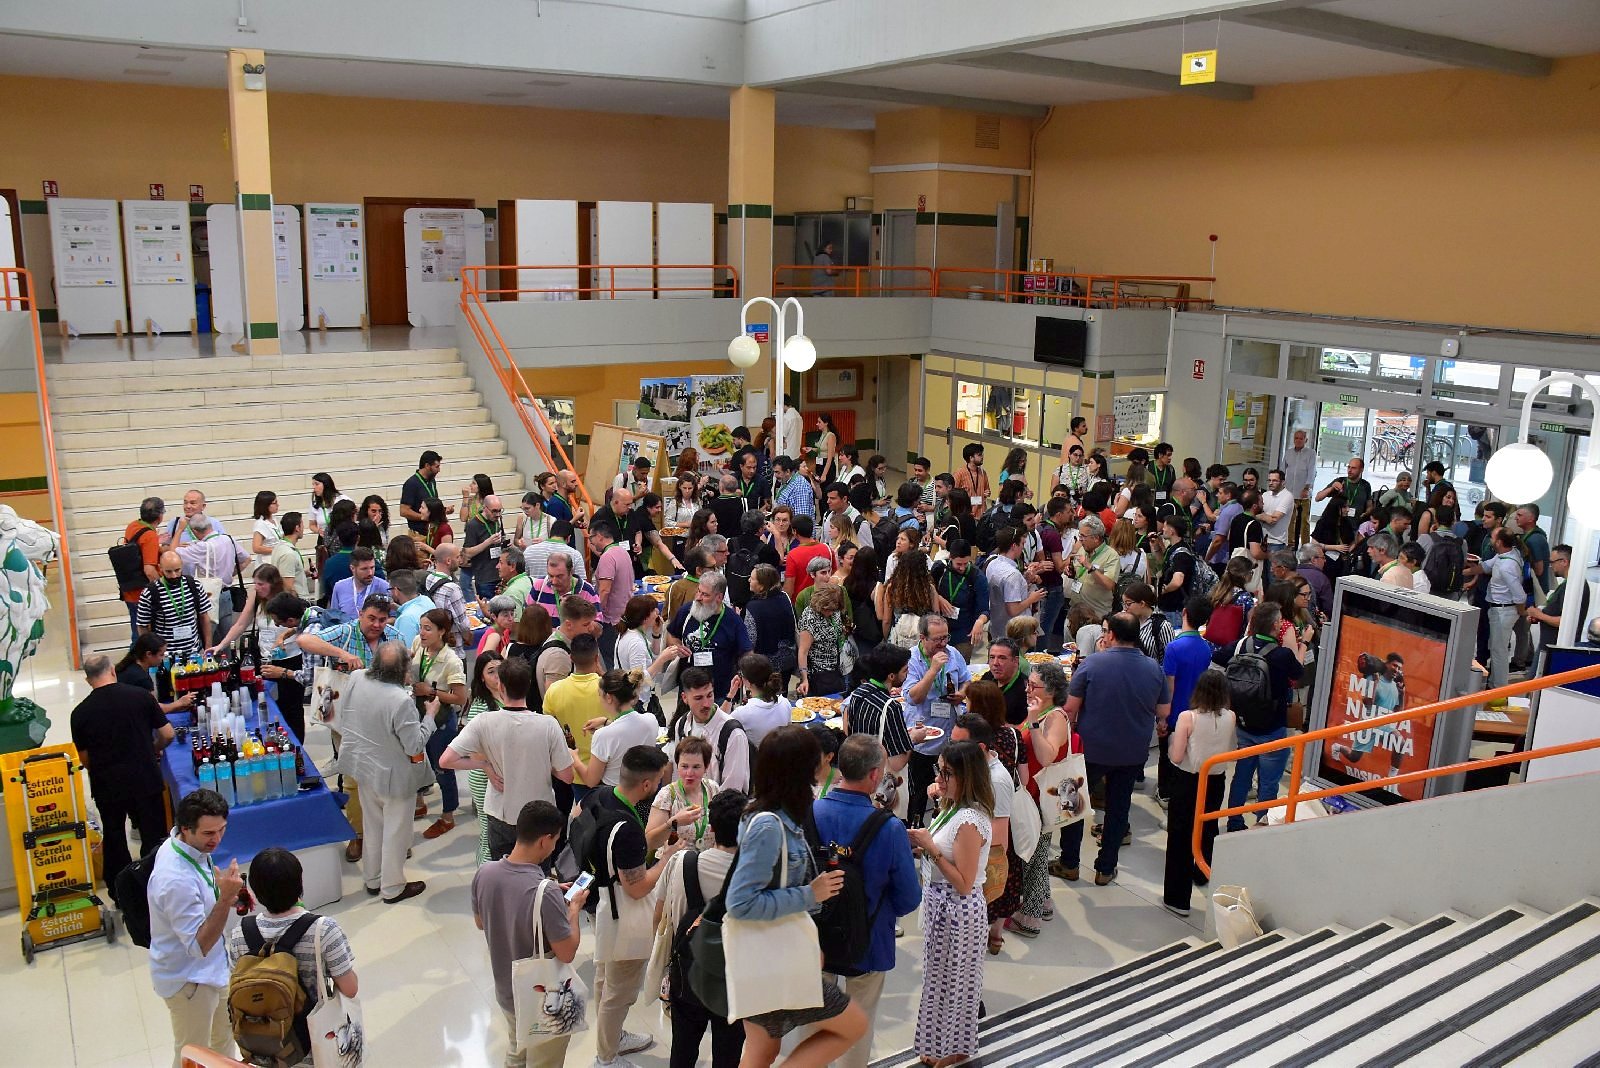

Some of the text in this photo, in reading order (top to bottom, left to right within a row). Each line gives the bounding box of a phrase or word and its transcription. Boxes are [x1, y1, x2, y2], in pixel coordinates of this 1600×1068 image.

[1348, 673, 1375, 699] MI
[1345, 696, 1412, 734] NUEA
[26, 777, 64, 790] Estrella
[27, 785, 64, 799] Galicia
[31, 810, 68, 826] Estrella
[33, 844, 73, 859] Estrella
[35, 853, 72, 867] Galicia
[38, 878, 78, 892] Estrella
[40, 912, 84, 929] Estrella
[43, 921, 83, 937] Galicia
